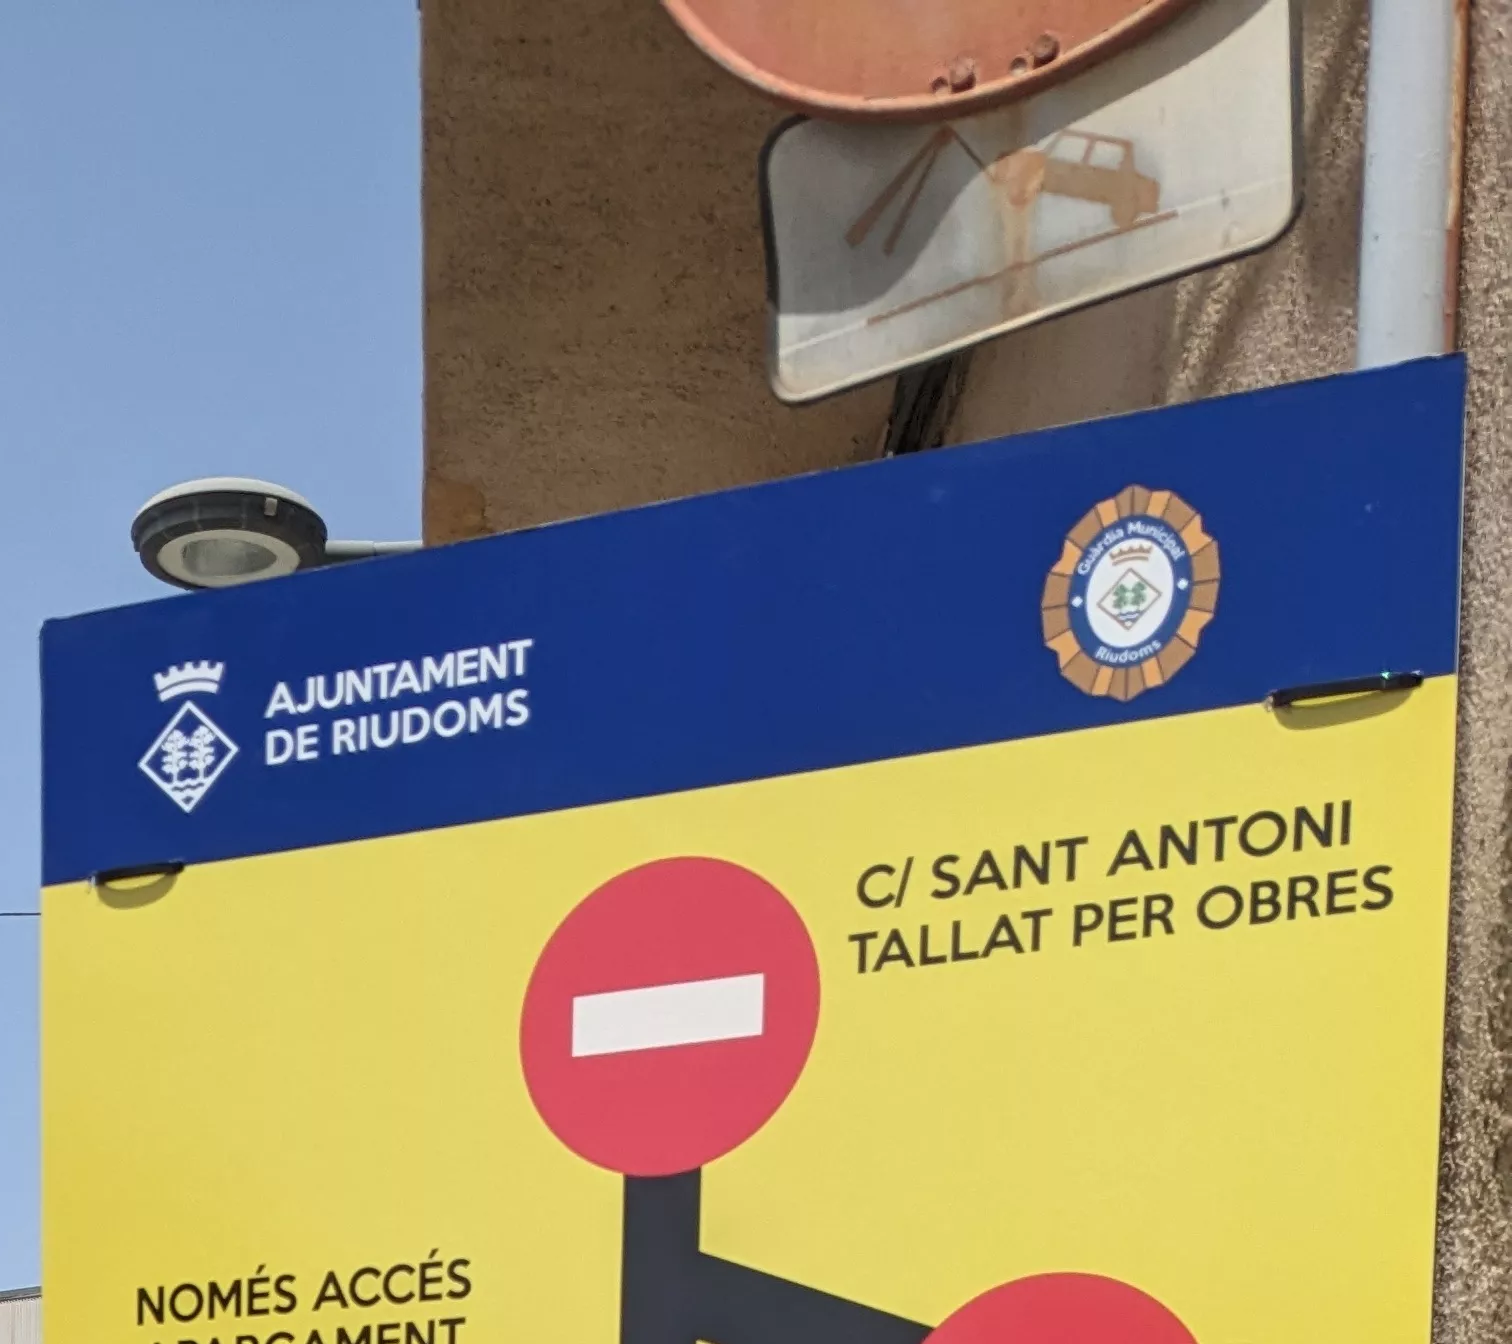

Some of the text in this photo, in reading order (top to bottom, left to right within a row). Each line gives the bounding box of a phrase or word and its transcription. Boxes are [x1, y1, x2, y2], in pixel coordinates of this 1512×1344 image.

[1078, 521, 1184, 575] Guardia Municipal
[263, 639, 533, 720] AJUNTAMENT
[1094, 640, 1162, 663] Riudoms
[265, 689, 529, 765] DE RIUDOMS
[856, 800, 1352, 909] C/ SANT ANTONI
[849, 865, 1394, 974] TALLAT PER OBRES
[137, 1248, 472, 1325] NOMÉS ACCÉS
